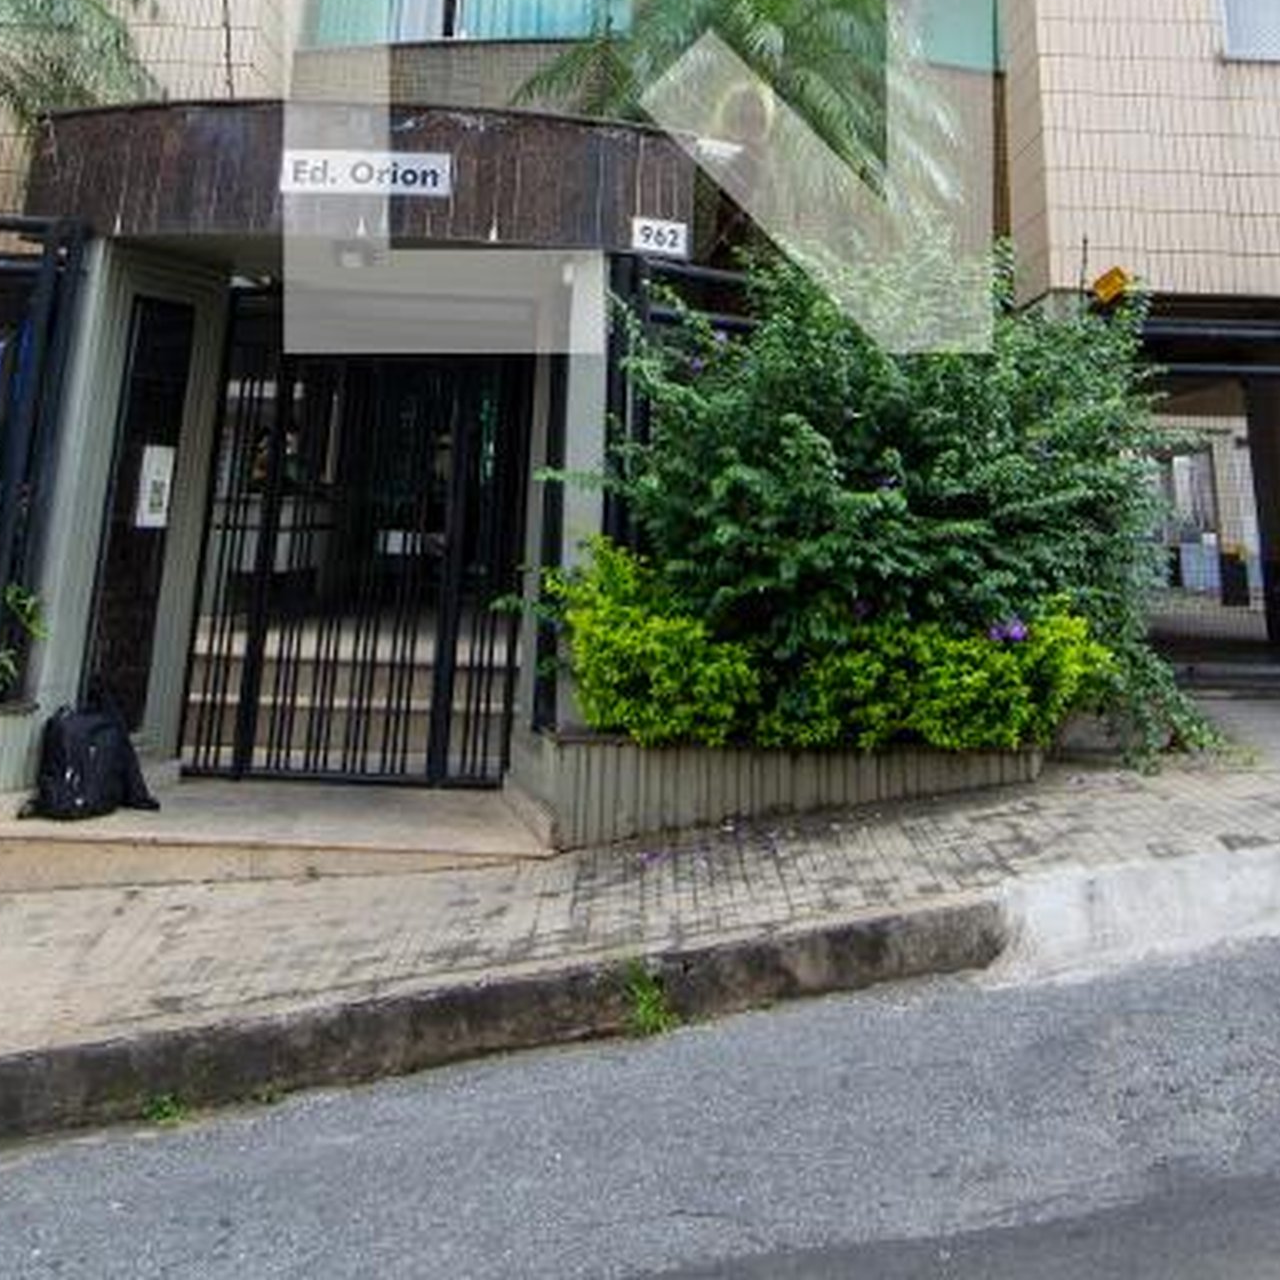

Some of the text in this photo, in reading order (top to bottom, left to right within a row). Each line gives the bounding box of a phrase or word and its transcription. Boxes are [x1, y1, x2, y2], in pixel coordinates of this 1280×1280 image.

[292, 159, 440, 188] Ed. Orion
[640, 225, 680, 248] 962
